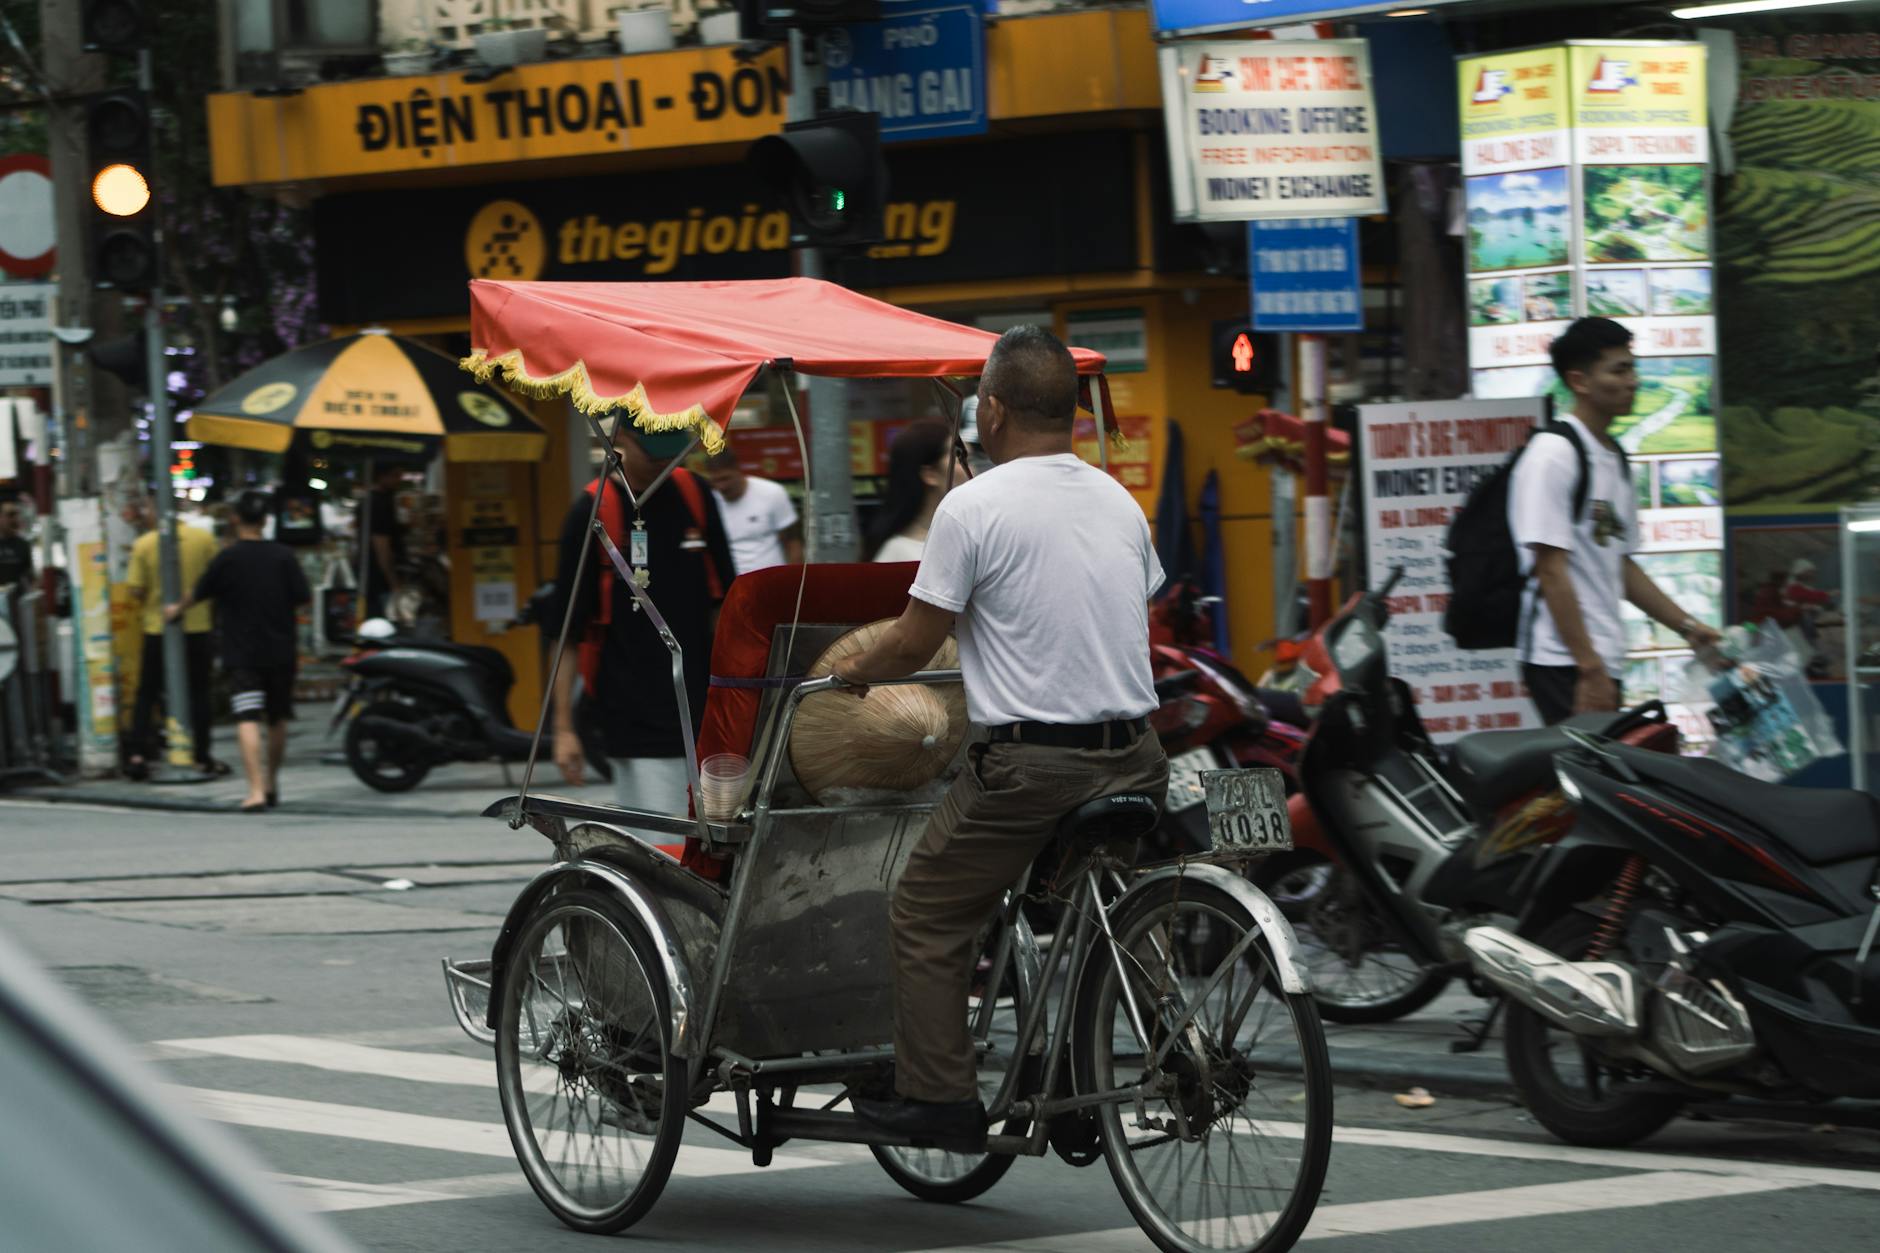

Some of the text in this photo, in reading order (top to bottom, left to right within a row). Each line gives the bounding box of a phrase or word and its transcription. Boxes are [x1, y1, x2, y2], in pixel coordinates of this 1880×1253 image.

[830, 67, 972, 119] HÀNG GAI
[356, 88, 477, 159] ĐIỆN
[486, 79, 645, 143] THOẠI
[1198, 106, 1368, 136] BOOKING OFFICE
[1200, 145, 1373, 165] FREE INFORMATION
[1206, 174, 1374, 201] MONEY EXCHANGE
[1374, 467, 1438, 498] MONEY
